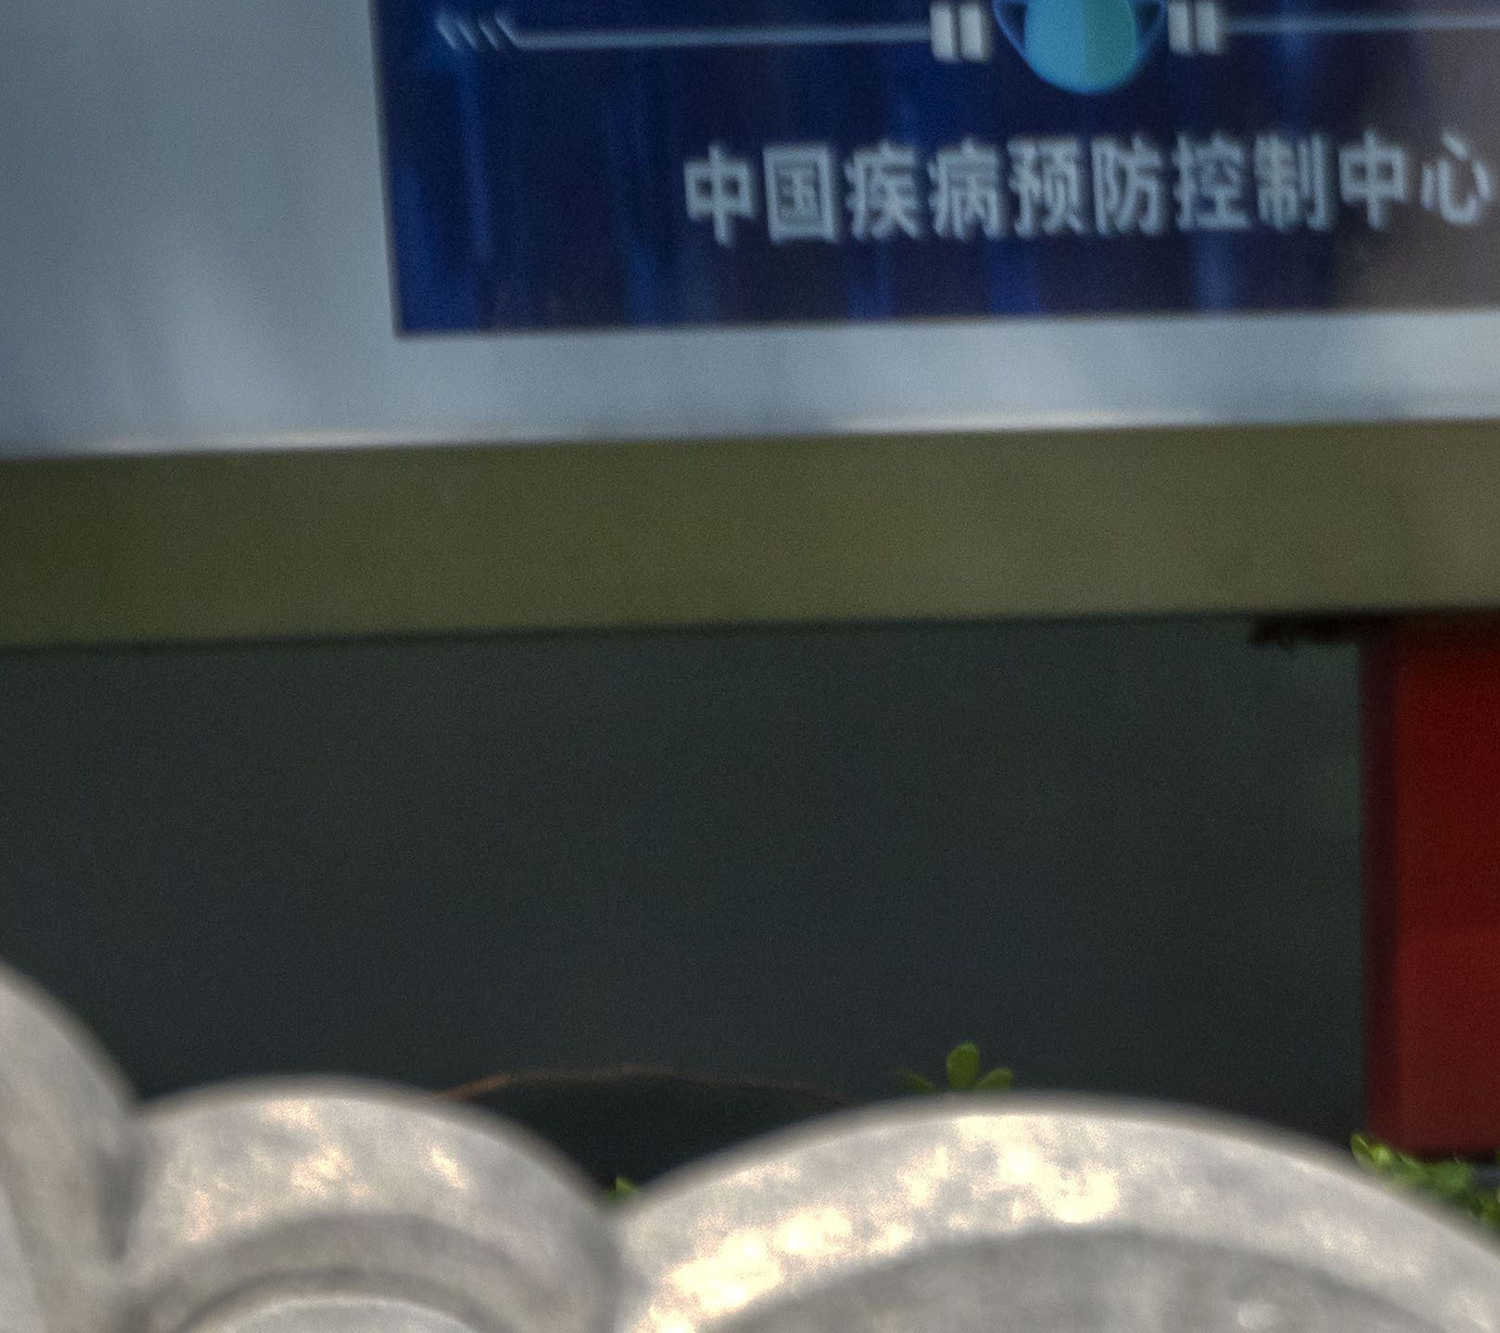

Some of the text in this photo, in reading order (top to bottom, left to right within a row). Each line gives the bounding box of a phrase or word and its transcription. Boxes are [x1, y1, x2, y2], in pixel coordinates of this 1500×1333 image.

[684, 131, 1495, 245] 中国疾病预防控制中心
